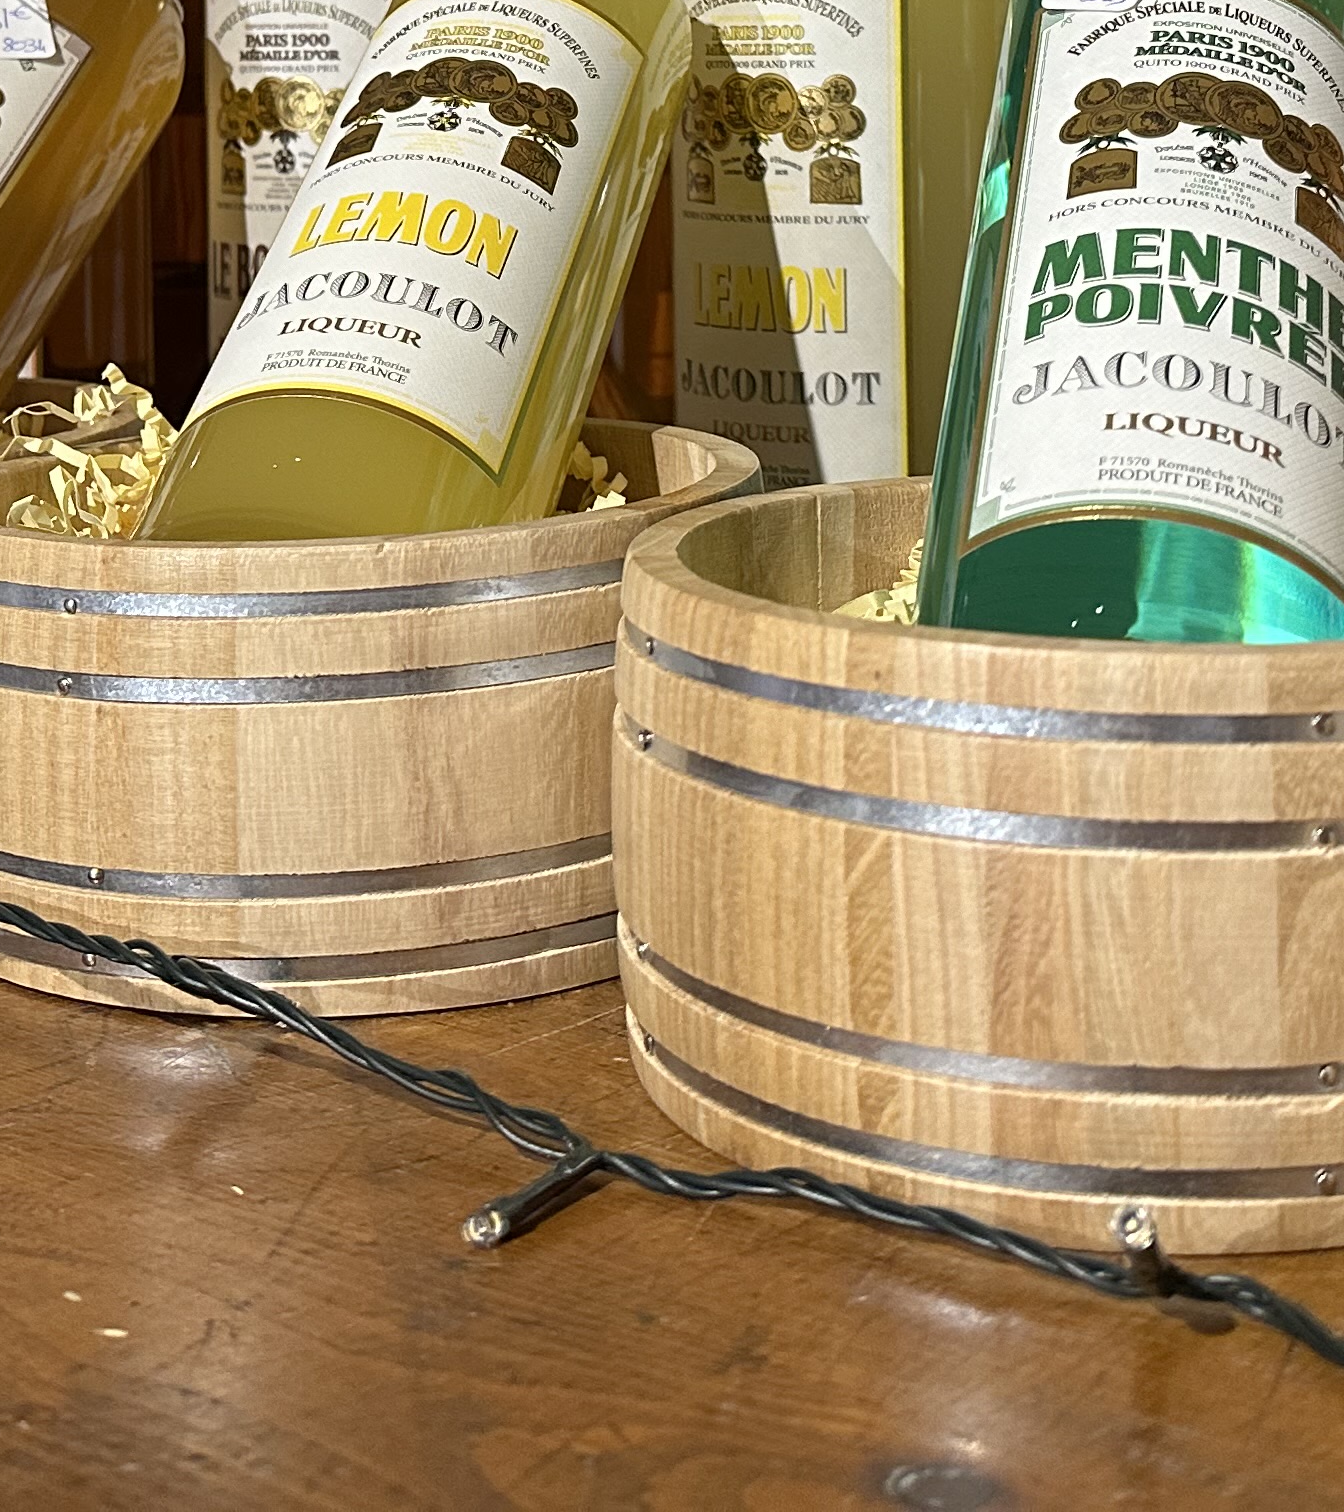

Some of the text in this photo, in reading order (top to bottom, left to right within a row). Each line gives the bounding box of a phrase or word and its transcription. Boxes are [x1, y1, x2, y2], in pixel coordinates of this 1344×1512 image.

[245, 33, 331, 47] PARIS 1900
[422, 1, 477, 23] SPÉCIALE
[490, 0, 550, 28] LIQUEURS
[546, 22, 601, 80] SUPERFINES
[424, 25, 545, 50] PARIS 1900
[711, 24, 806, 41] PARIS 1900
[1067, 11, 1136, 57] FABRIQUE
[1135, 0, 1205, 19] SPÉCIALE
[1224, 3, 1292, 48] LIQUEURS
[1153, 19, 1296, 58] EXPOSITION UNIVERSELLE
[239, 48, 341, 62] MÉDAILLE D'OR
[316, 65, 340, 73] PRIX
[405, 47, 547, 75] QUITO GRAND PRIX
[504, 41, 552, 67] D'OR
[750, 60, 816, 69] GRAND PRIX
[774, 43, 817, 56] D'OR
[1134, 42, 1309, 96] MÉDAILLE D'OR
[1149, 29, 1297, 73] PARIS 1900
[1133, 58, 1308, 107] QUITO 1909 GRAND PRIX
[342, 153, 556, 213] CONCOURS MEMBRE DU JURY
[288, 191, 519, 280] LEMON
[700, 211, 870, 225] CONCOURS MEMBRE DU JURY
[1048, 201, 1098, 223] HORS
[1099, 195, 1211, 211] CONCOURS
[1212, 205, 1297, 243] MEMBRE
[1298, 237, 1323, 258] DU
[236, 270, 520, 358] JACOULOT
[693, 261, 848, 334] LEMON
[277, 316, 422, 349] LIQUEUR
[260, 357, 408, 385] PRODUIT DE FRANCE
[308, 348, 411, 374] Romanèche Thorins
[680, 357, 881, 406] JACOULOT
[712, 418, 811, 444] LIQUEUR
[1102, 412, 1287, 469] LIQUEUR
[1097, 467, 1285, 519] PRODUIT DE FRANCE
[1109, 456, 1286, 504] 71570 Romanèche Thorins
